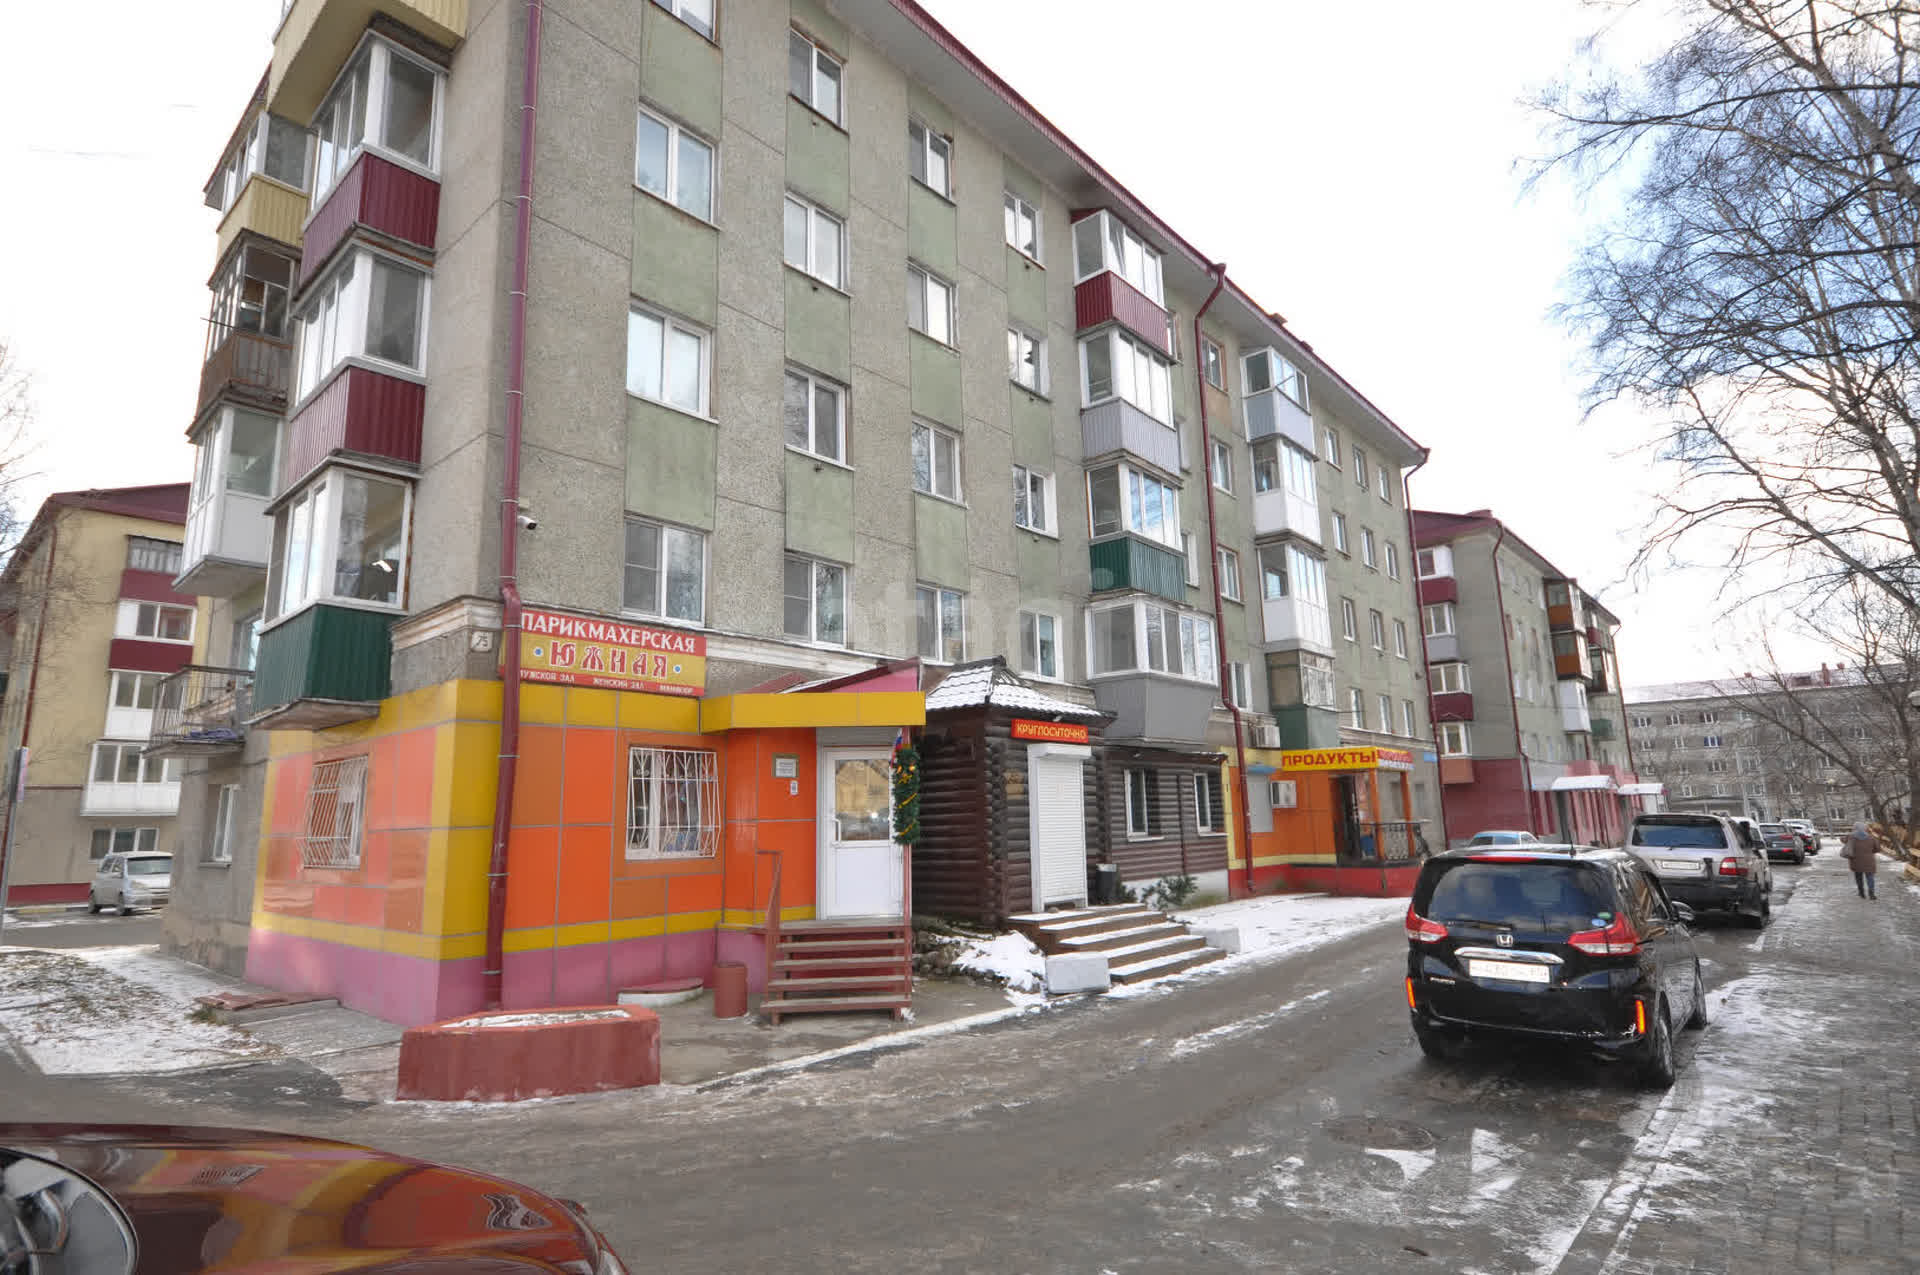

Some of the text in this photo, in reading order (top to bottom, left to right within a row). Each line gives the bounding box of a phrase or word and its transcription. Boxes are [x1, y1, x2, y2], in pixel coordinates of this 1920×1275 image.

[521, 612, 696, 653] ПАРИКМАХЕРСКАЯ
[549, 640, 668, 679] ЮЖНАЯ
[1016, 723, 1087, 740] КРУГЛОСУТОЧНО
[1281, 751, 1376, 767] ПРОДУКТЫ
